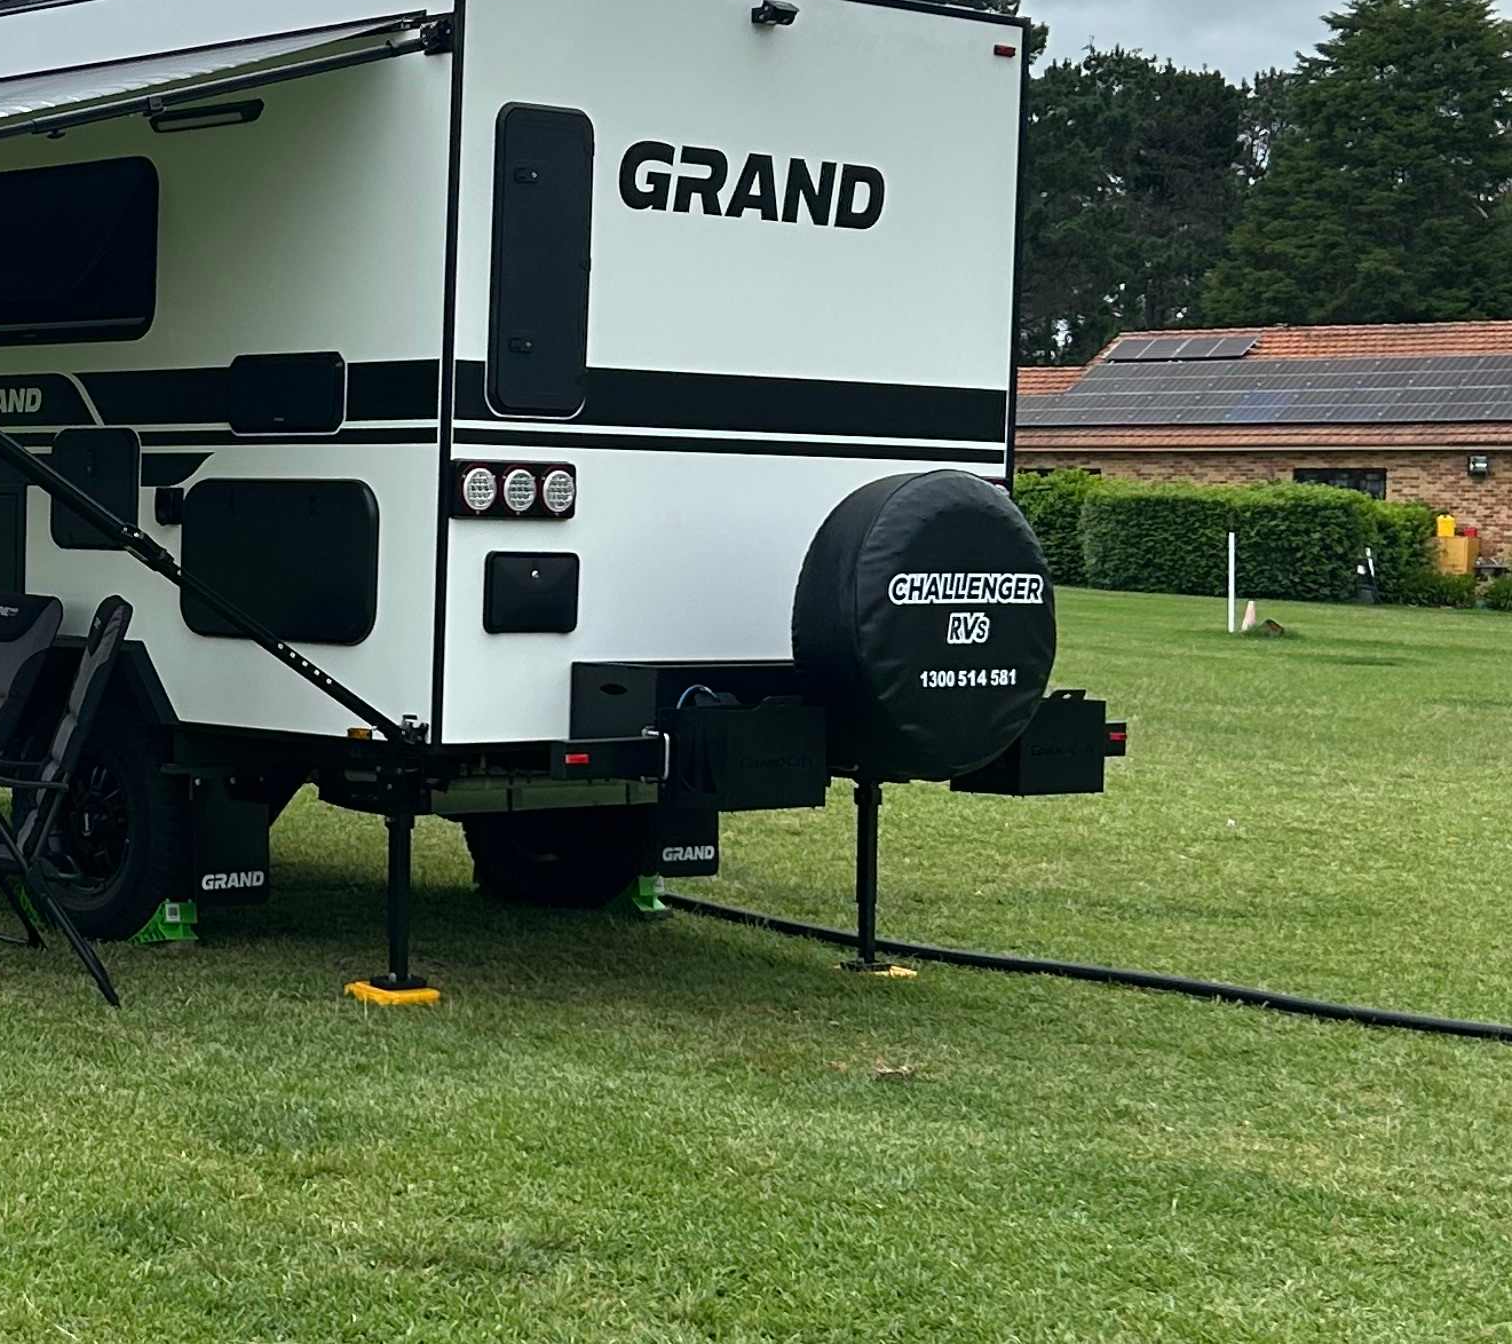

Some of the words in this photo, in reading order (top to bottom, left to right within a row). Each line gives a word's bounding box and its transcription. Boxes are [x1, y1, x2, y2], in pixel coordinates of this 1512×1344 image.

[619, 140, 885, 229] GRAND
[889, 573, 1044, 605] CHALLENGER
[947, 612, 989, 644] RVs
[920, 671, 955, 688] 1300
[957, 670, 987, 687] 514
[990, 668, 1017, 686] 581
[662, 845, 715, 862] GRAND
[201, 870, 265, 891] GRAND
